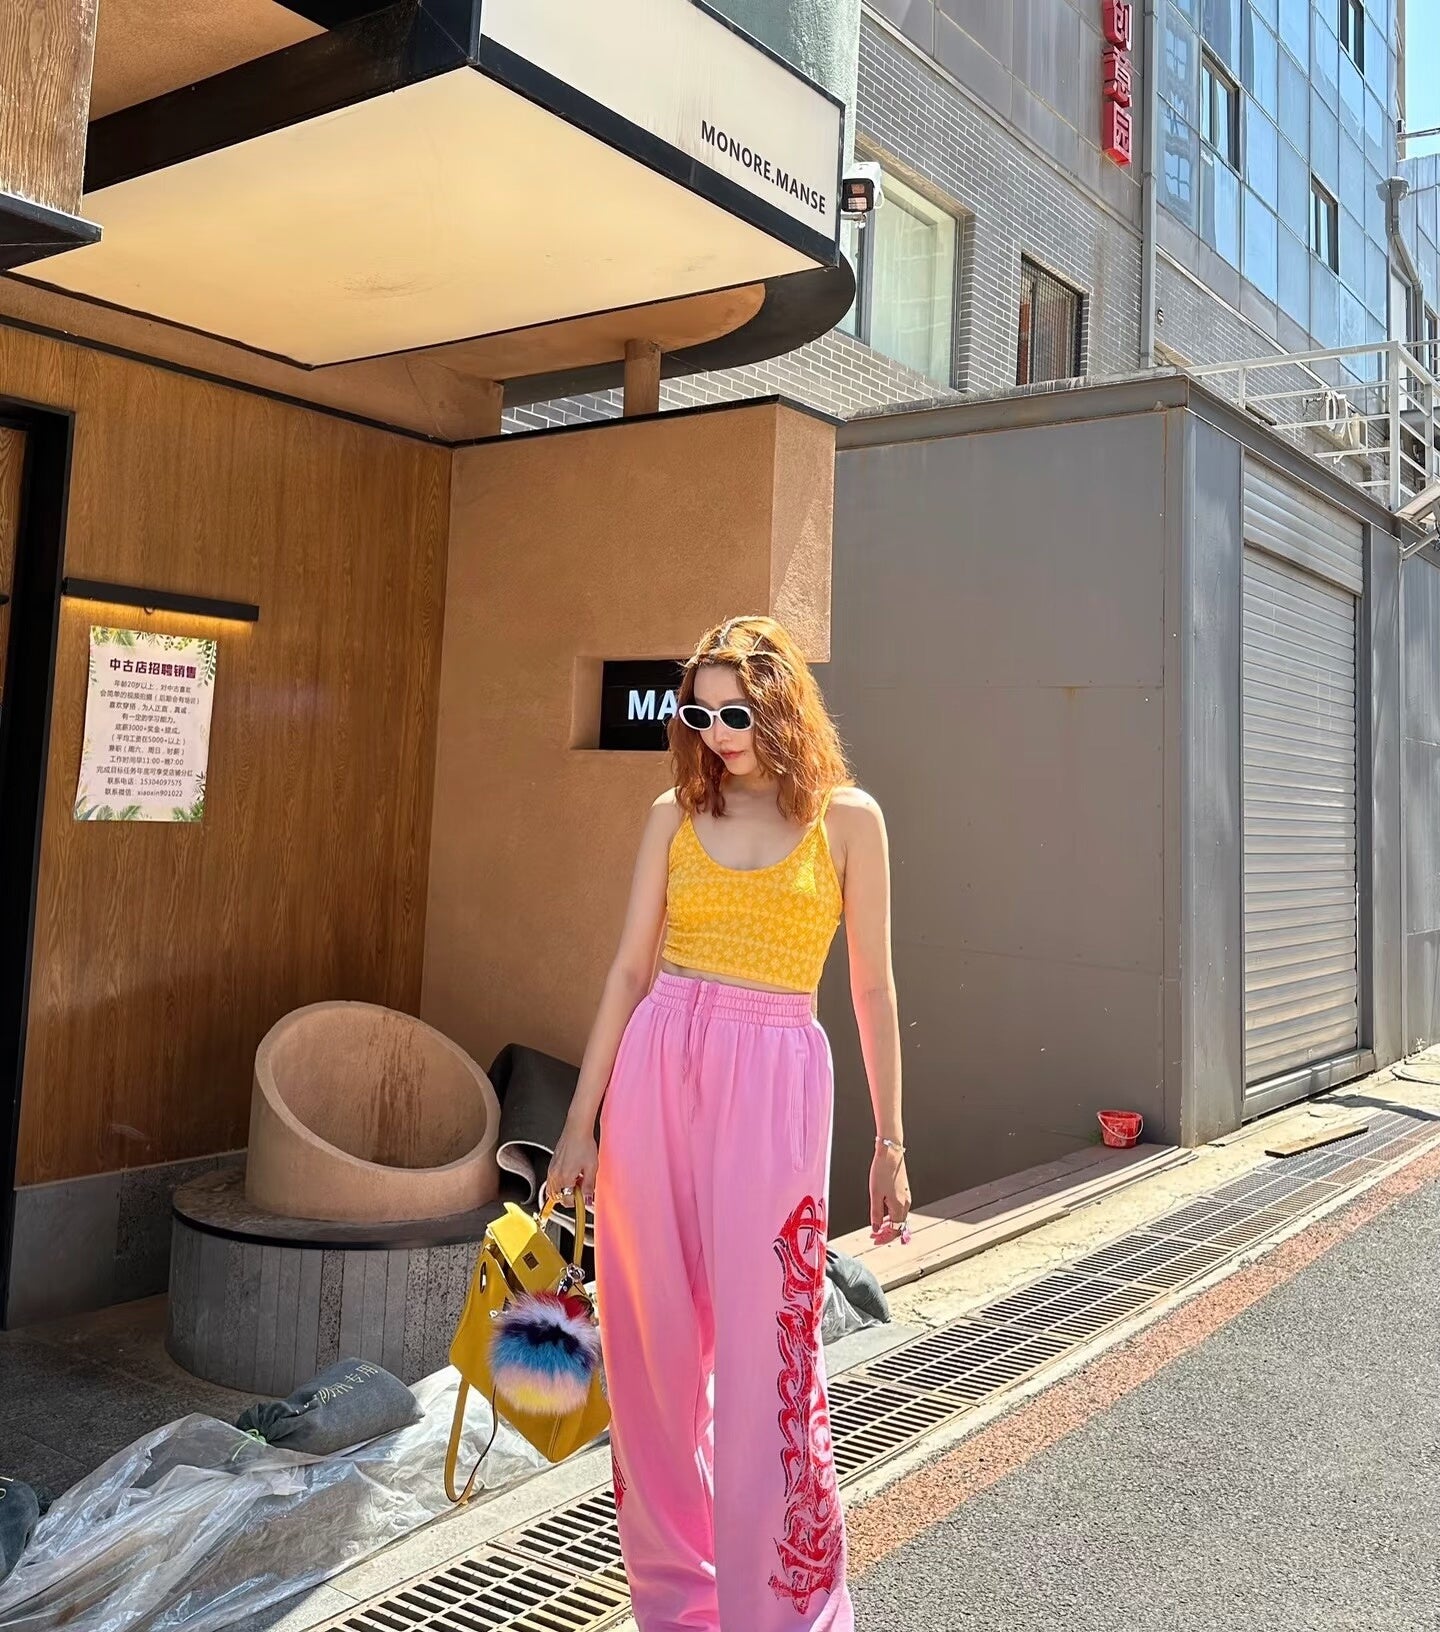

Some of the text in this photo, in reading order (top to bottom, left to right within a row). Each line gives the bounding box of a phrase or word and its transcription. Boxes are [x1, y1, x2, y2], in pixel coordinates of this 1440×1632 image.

[701, 120, 826, 214] MONORE.MANSE
[109, 658, 197, 679] 中古店招聘销售
